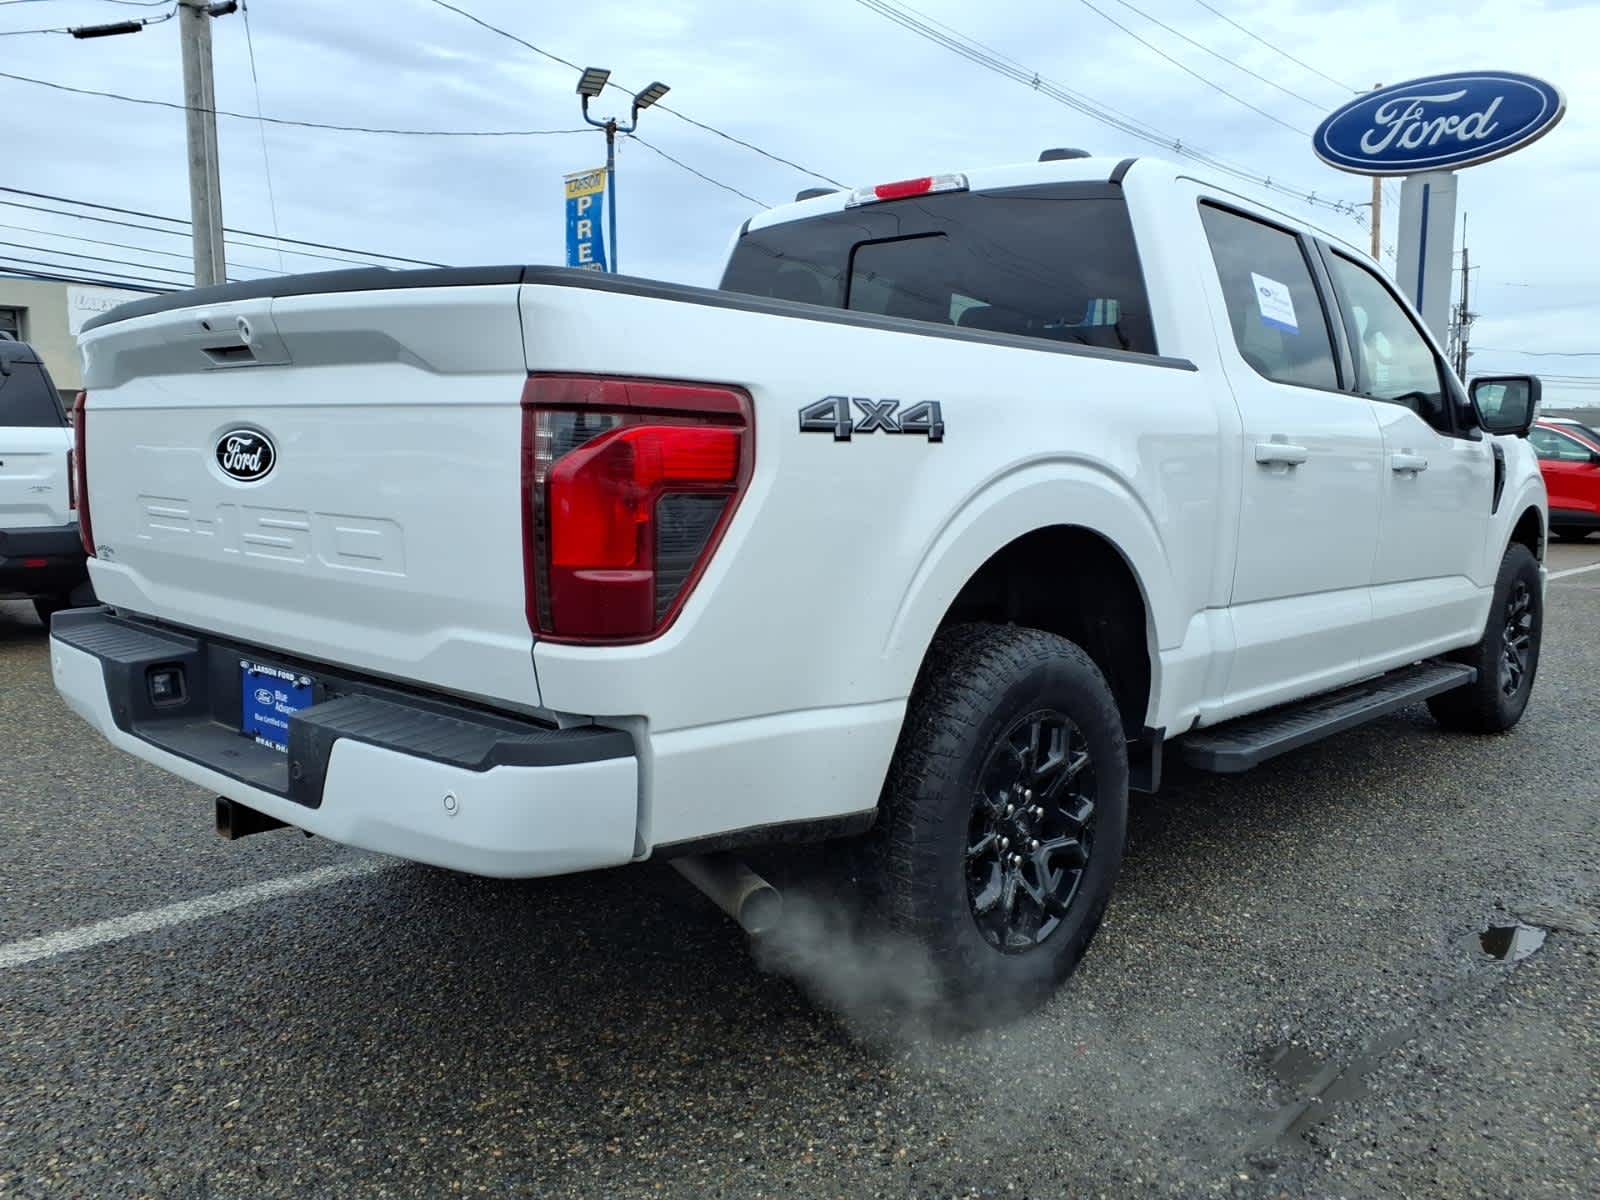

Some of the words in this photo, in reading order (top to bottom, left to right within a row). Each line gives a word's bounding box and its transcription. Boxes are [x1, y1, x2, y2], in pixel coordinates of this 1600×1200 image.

[1360, 89, 1505, 155] Ford
[223, 436, 262, 471] Ford
[136, 494, 406, 577] F-150
[254, 664, 276, 677] LARSON
[278, 670, 294, 681] FORD
[275, 690, 288, 703] Blue
